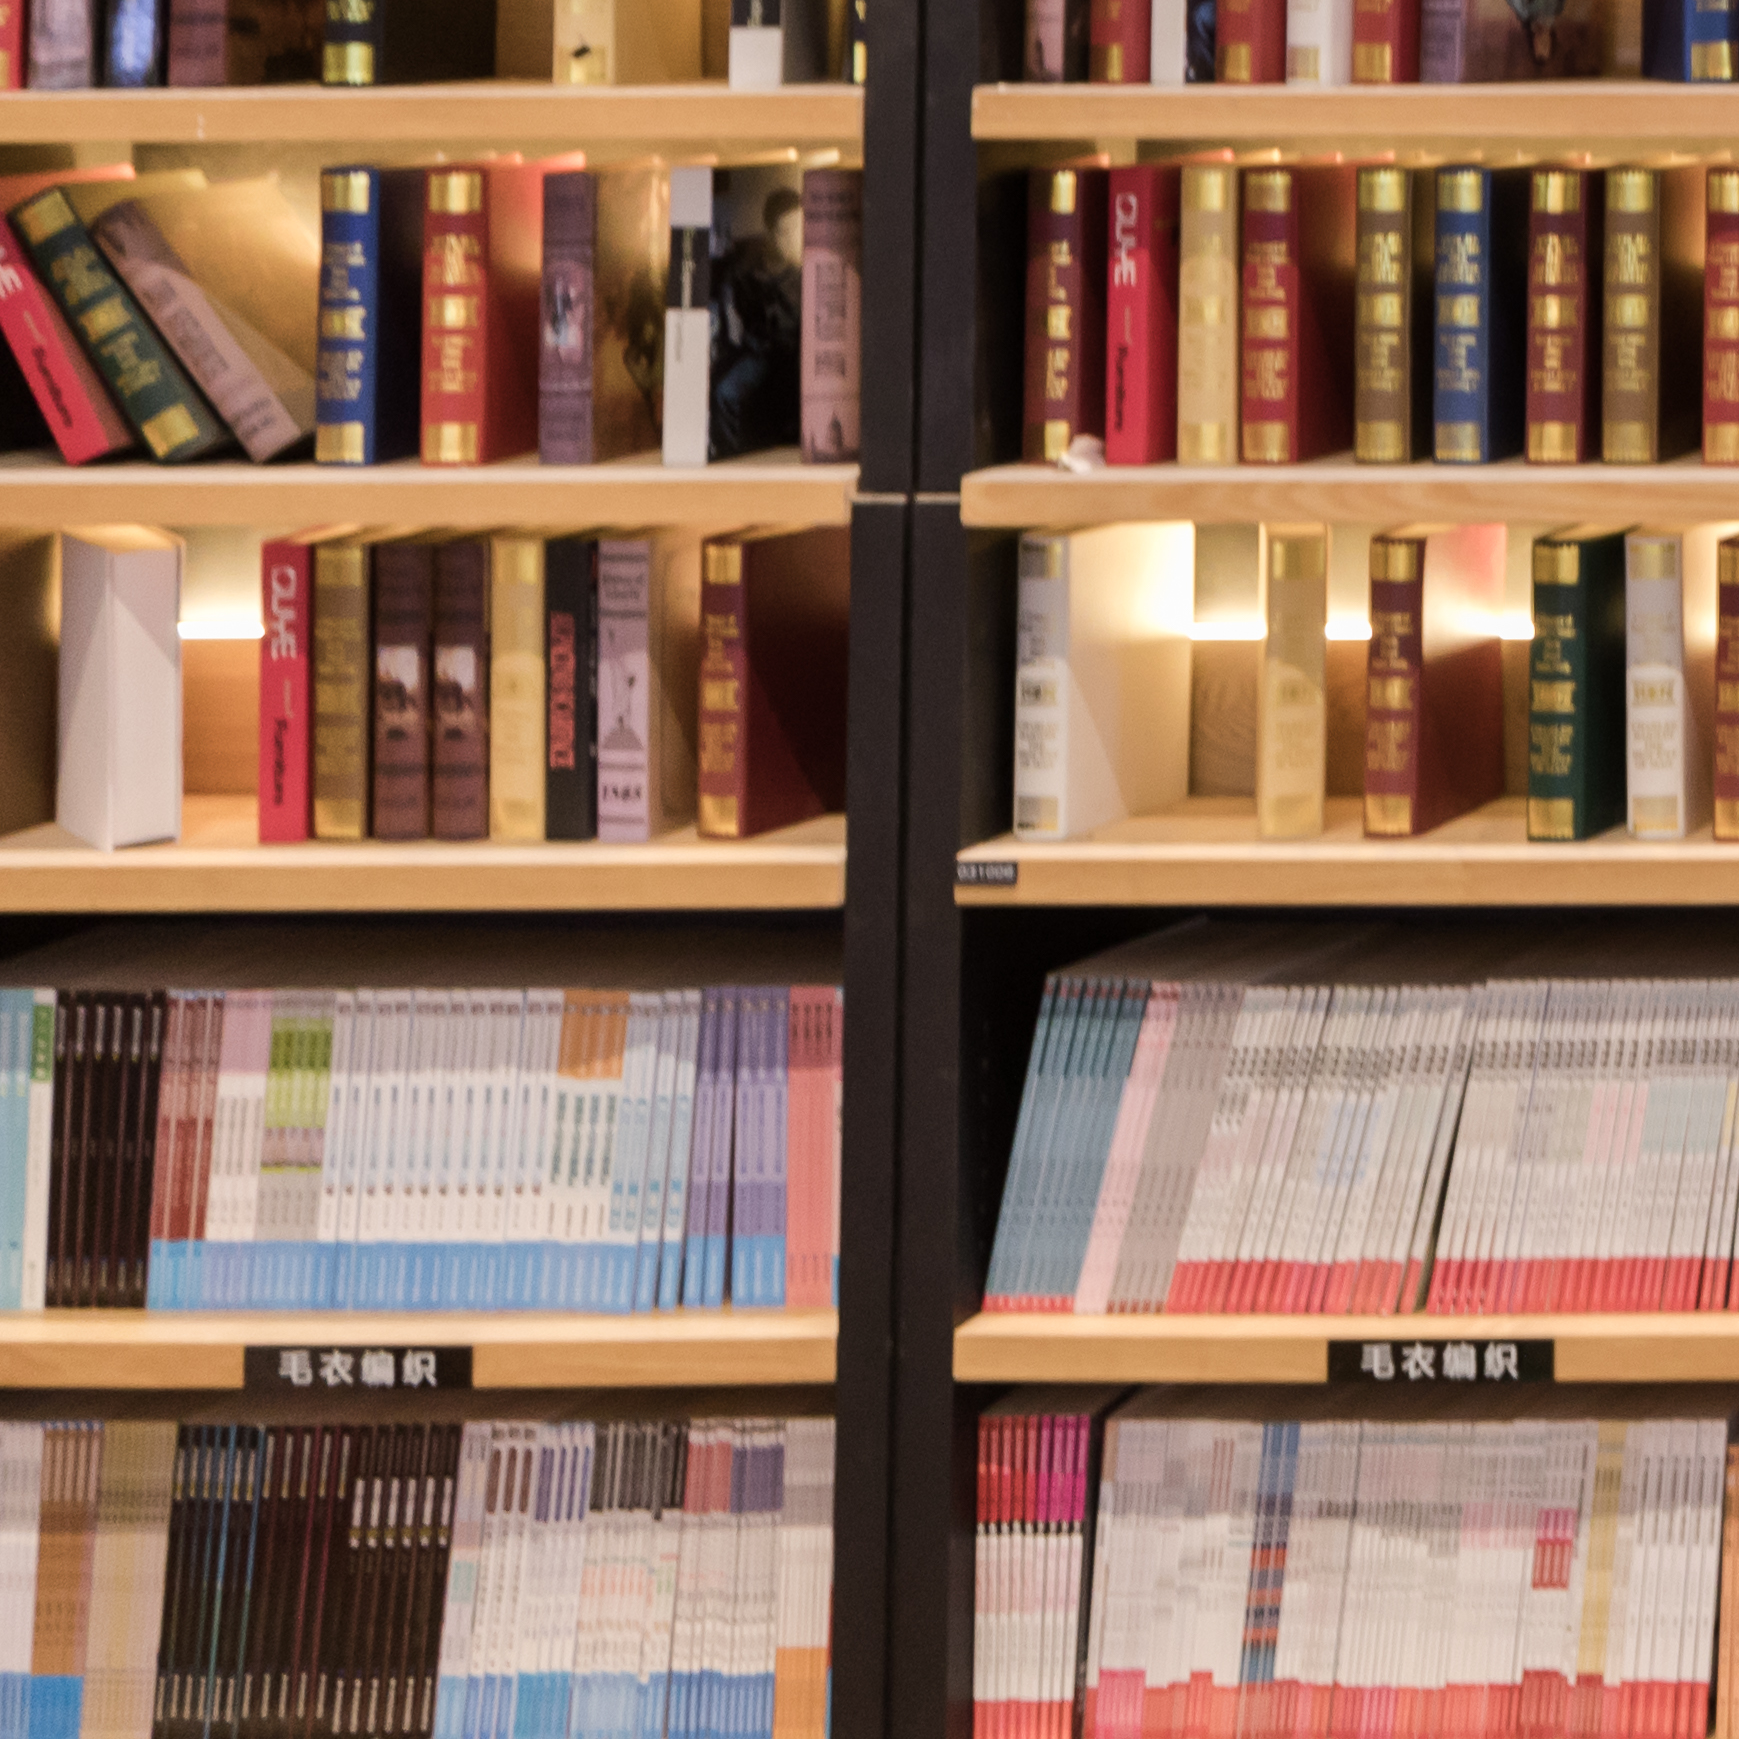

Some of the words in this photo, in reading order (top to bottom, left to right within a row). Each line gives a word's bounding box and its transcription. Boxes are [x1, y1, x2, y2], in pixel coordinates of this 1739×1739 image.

[277, 1348, 435, 1387] 毛衣编织
[1359, 1341, 1517, 1380] 毛衣编织
